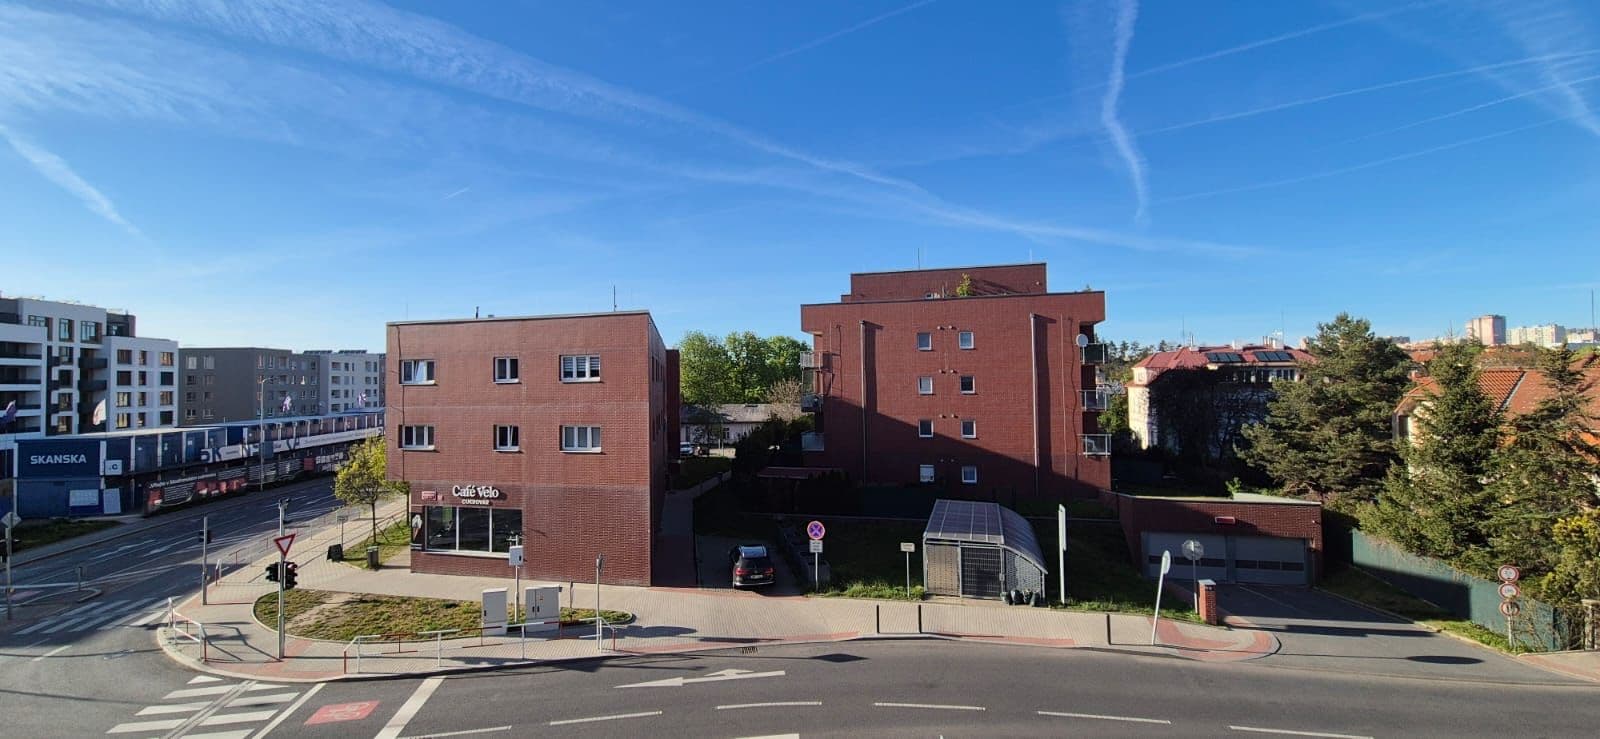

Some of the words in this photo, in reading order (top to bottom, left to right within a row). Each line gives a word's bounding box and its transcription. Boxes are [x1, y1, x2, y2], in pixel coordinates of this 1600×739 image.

[30, 454, 87, 465] SKANSKA
[452, 484, 476, 497] Café
[476, 485, 500, 498] Velo
